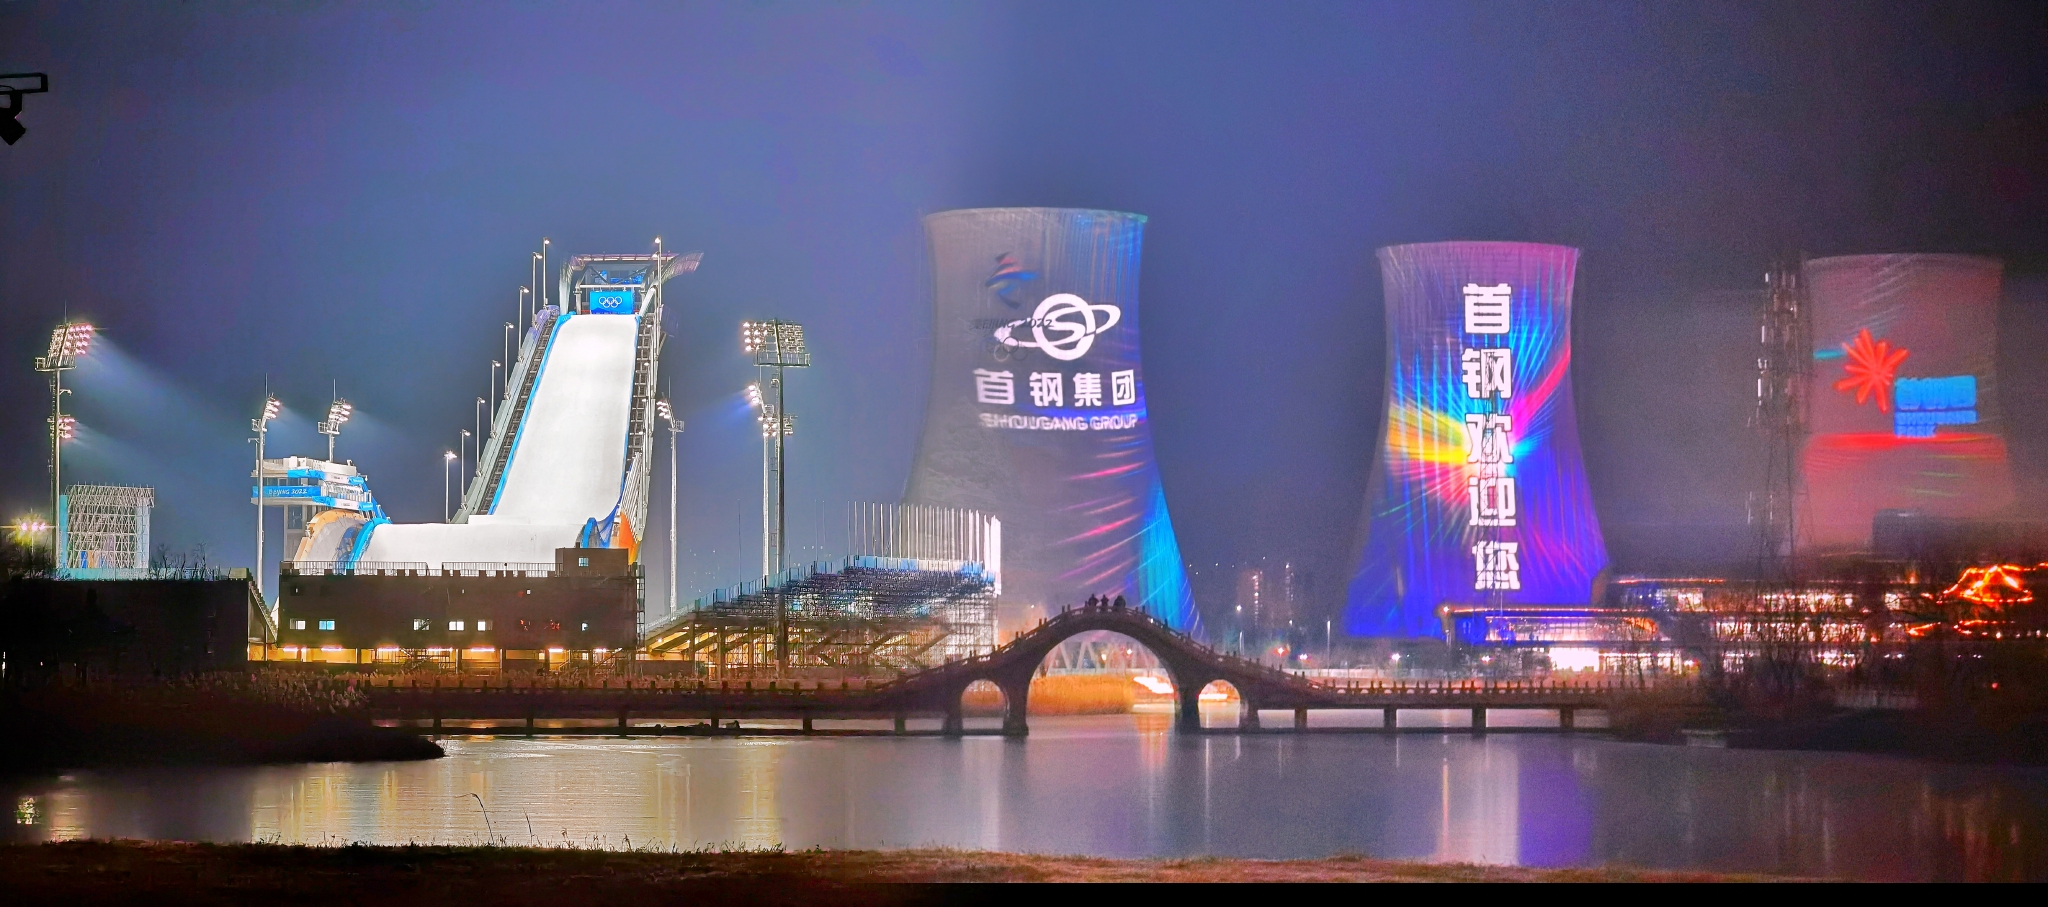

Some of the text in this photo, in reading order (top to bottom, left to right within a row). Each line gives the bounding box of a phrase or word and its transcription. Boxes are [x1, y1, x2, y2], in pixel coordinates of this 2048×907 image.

[973, 368, 1136, 408] 首钢集团
[979, 413, 1138, 430] SHOUGANG GROUP
[1462, 283, 1520, 590] 首钢欢迎您
